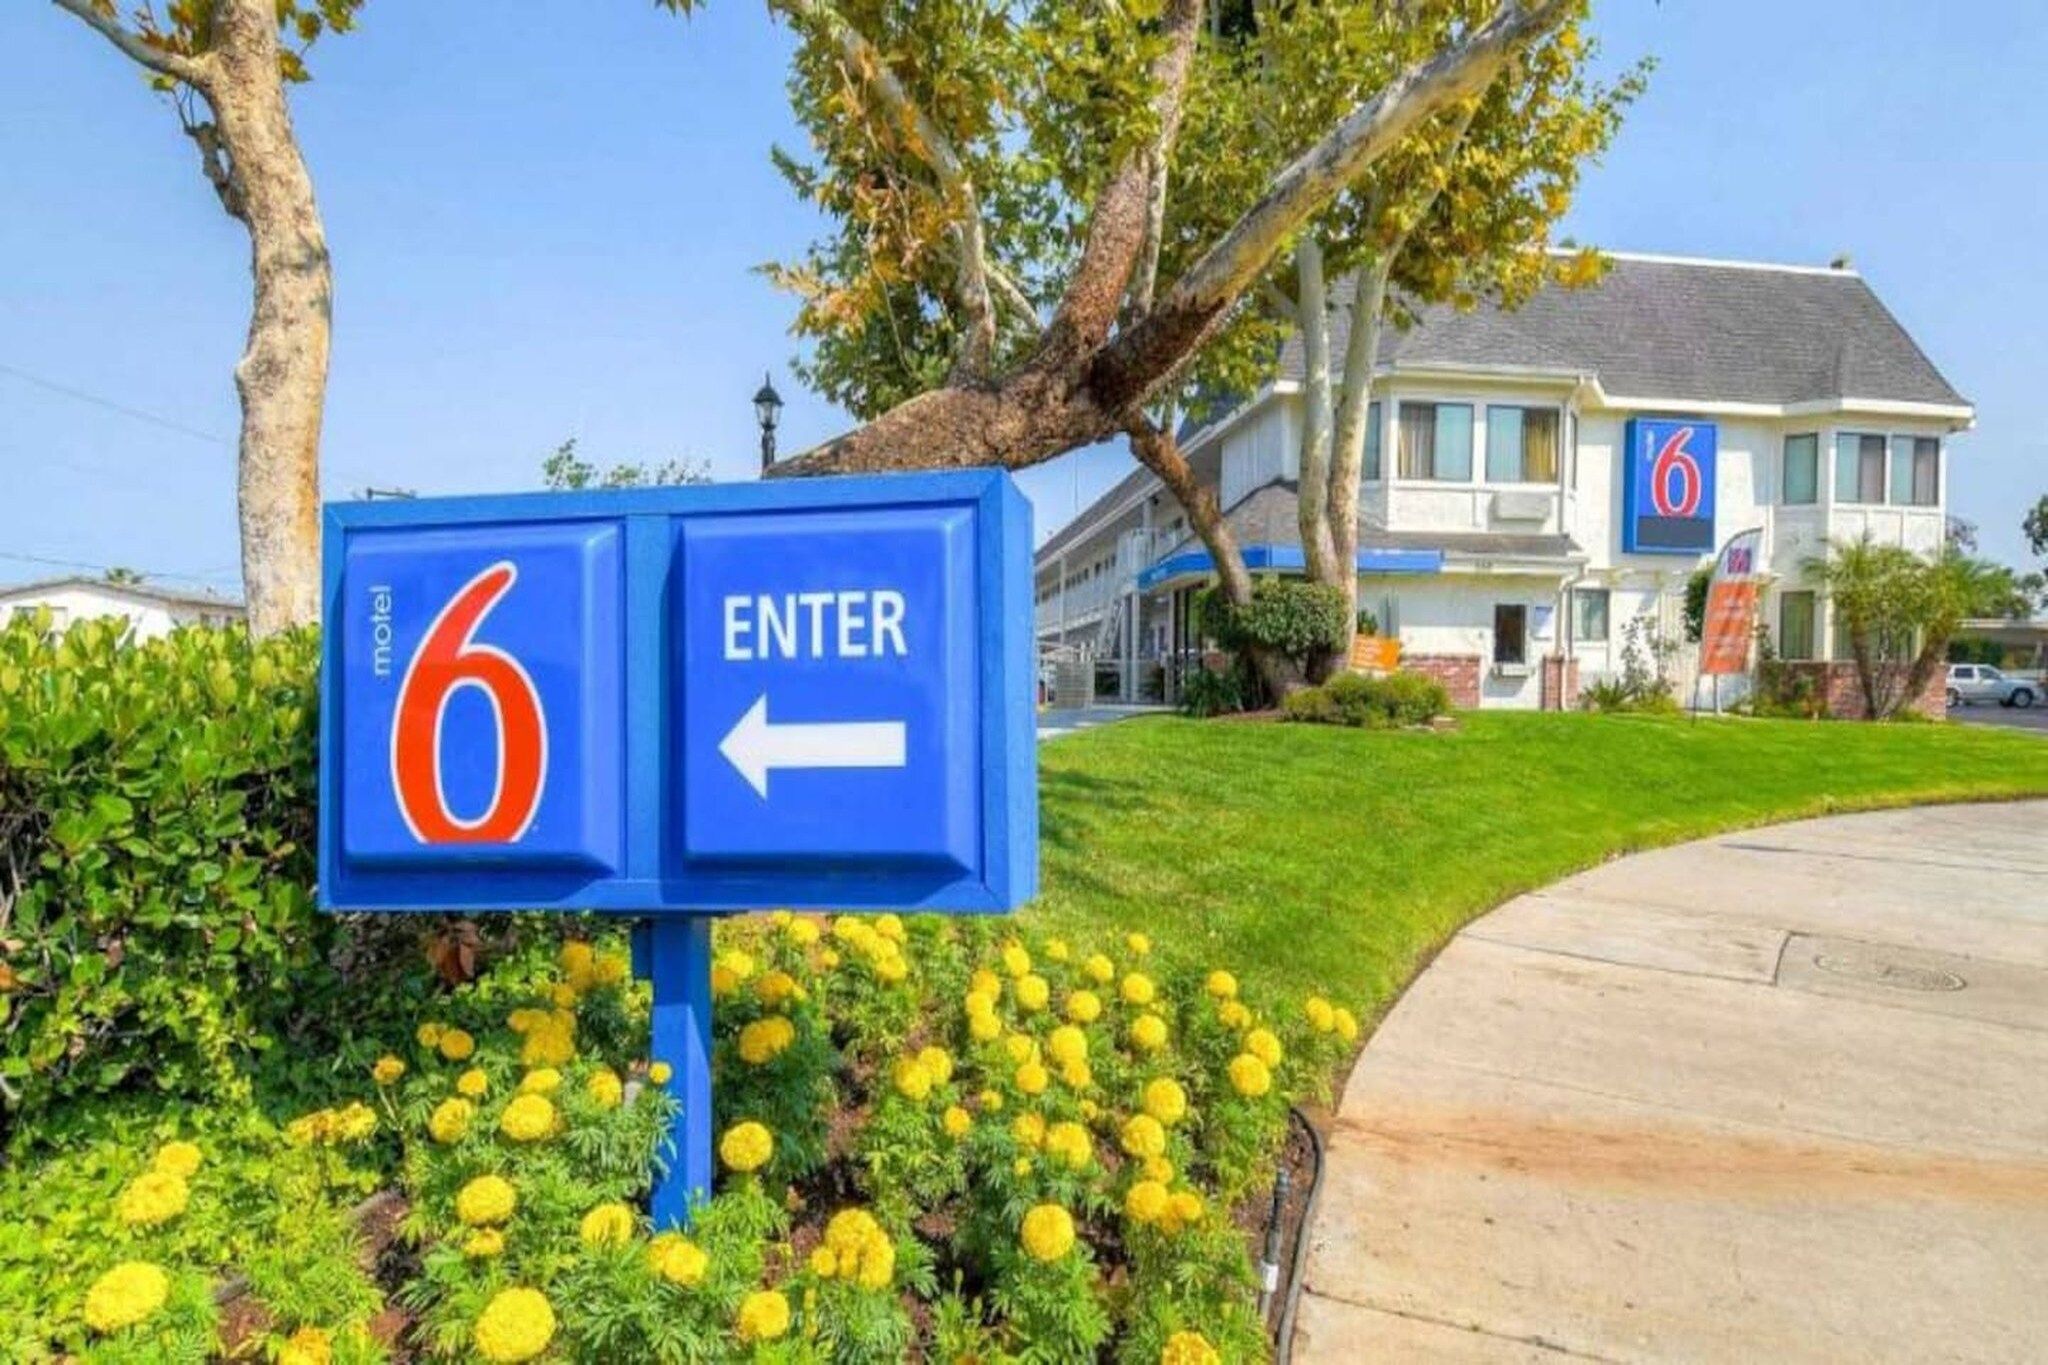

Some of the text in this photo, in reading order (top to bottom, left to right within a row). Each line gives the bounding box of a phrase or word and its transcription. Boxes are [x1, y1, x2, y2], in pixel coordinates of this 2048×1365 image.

[1652, 426, 1701, 518] 6
[369, 586, 391, 675] motel
[723, 590, 908, 661] ENTER
[391, 561, 548, 845] 6
